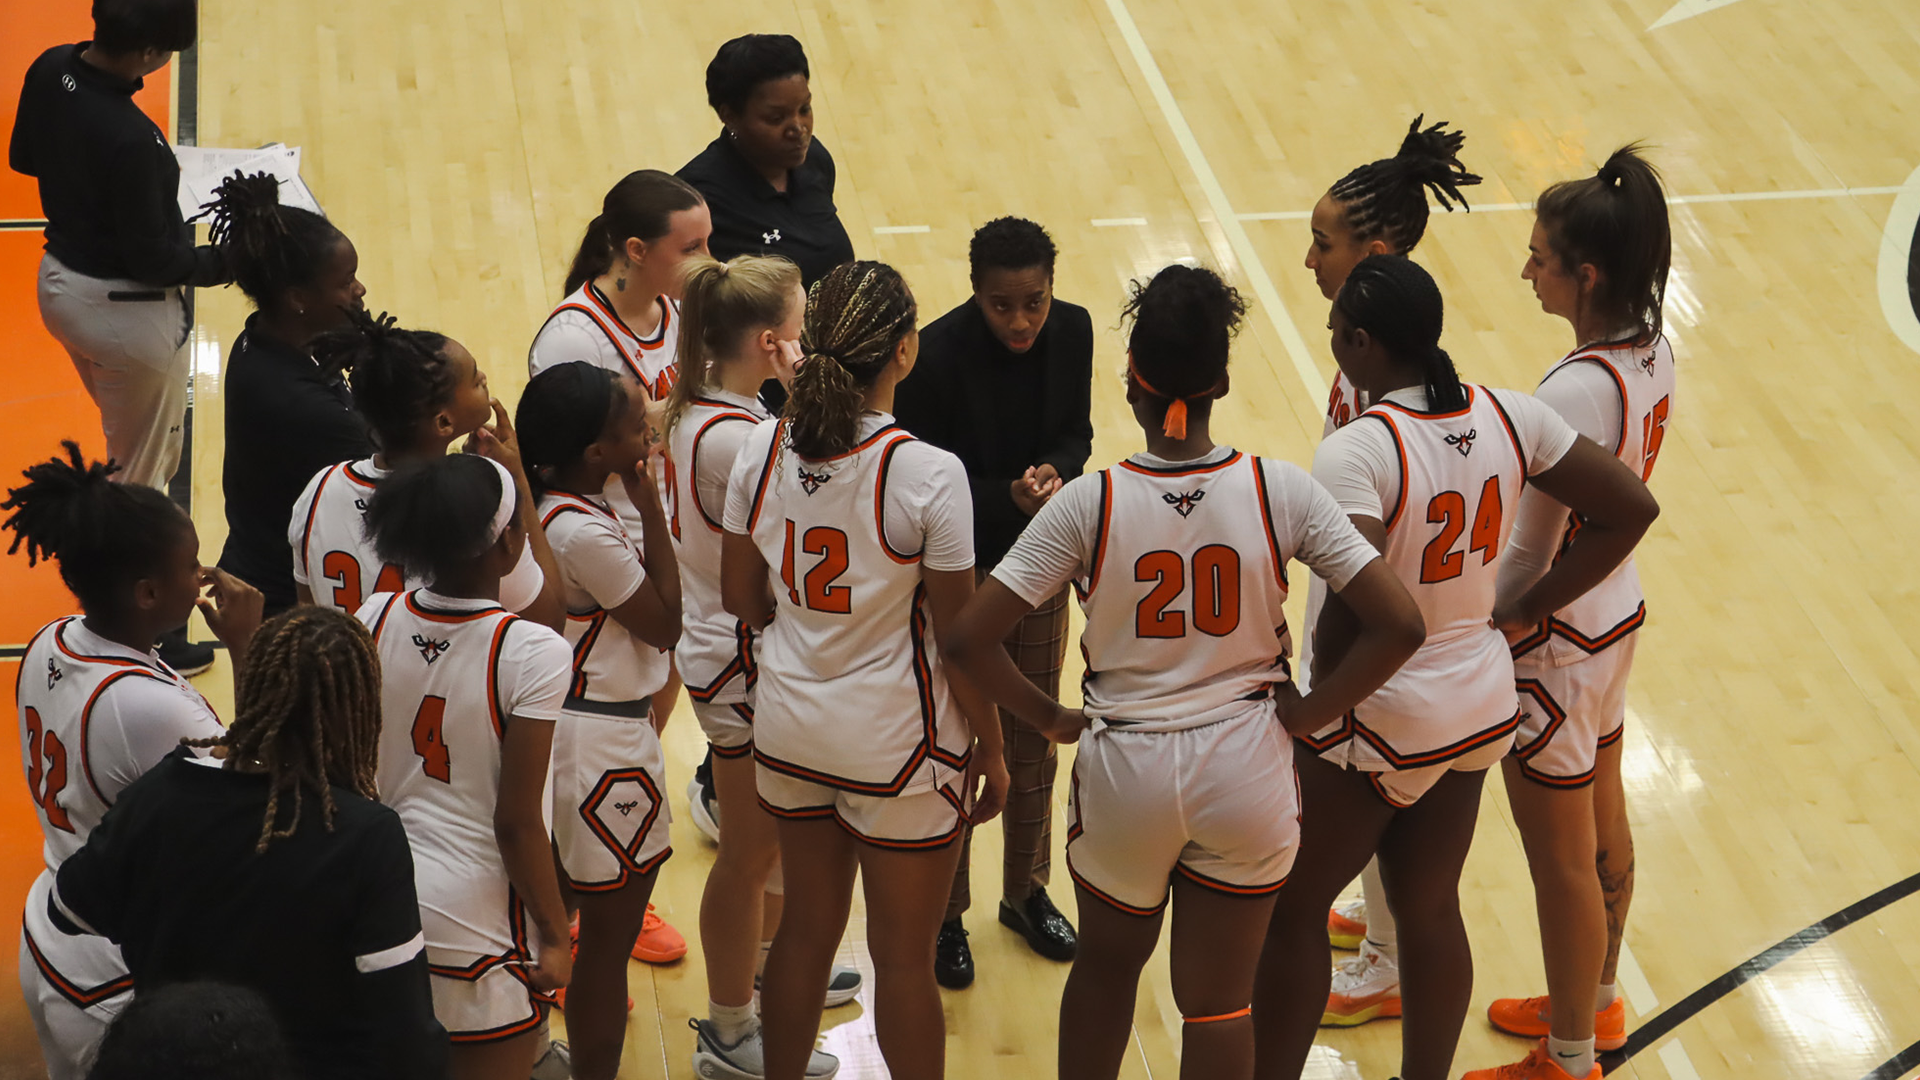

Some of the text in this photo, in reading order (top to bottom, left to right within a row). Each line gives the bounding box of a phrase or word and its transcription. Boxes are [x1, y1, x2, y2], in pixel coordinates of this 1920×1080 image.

[1641, 393, 1669, 484] 15
[780, 517, 851, 614] 12
[1419, 474, 1503, 584] 24
[1134, 543, 1241, 639] 20
[410, 694, 451, 785] 4
